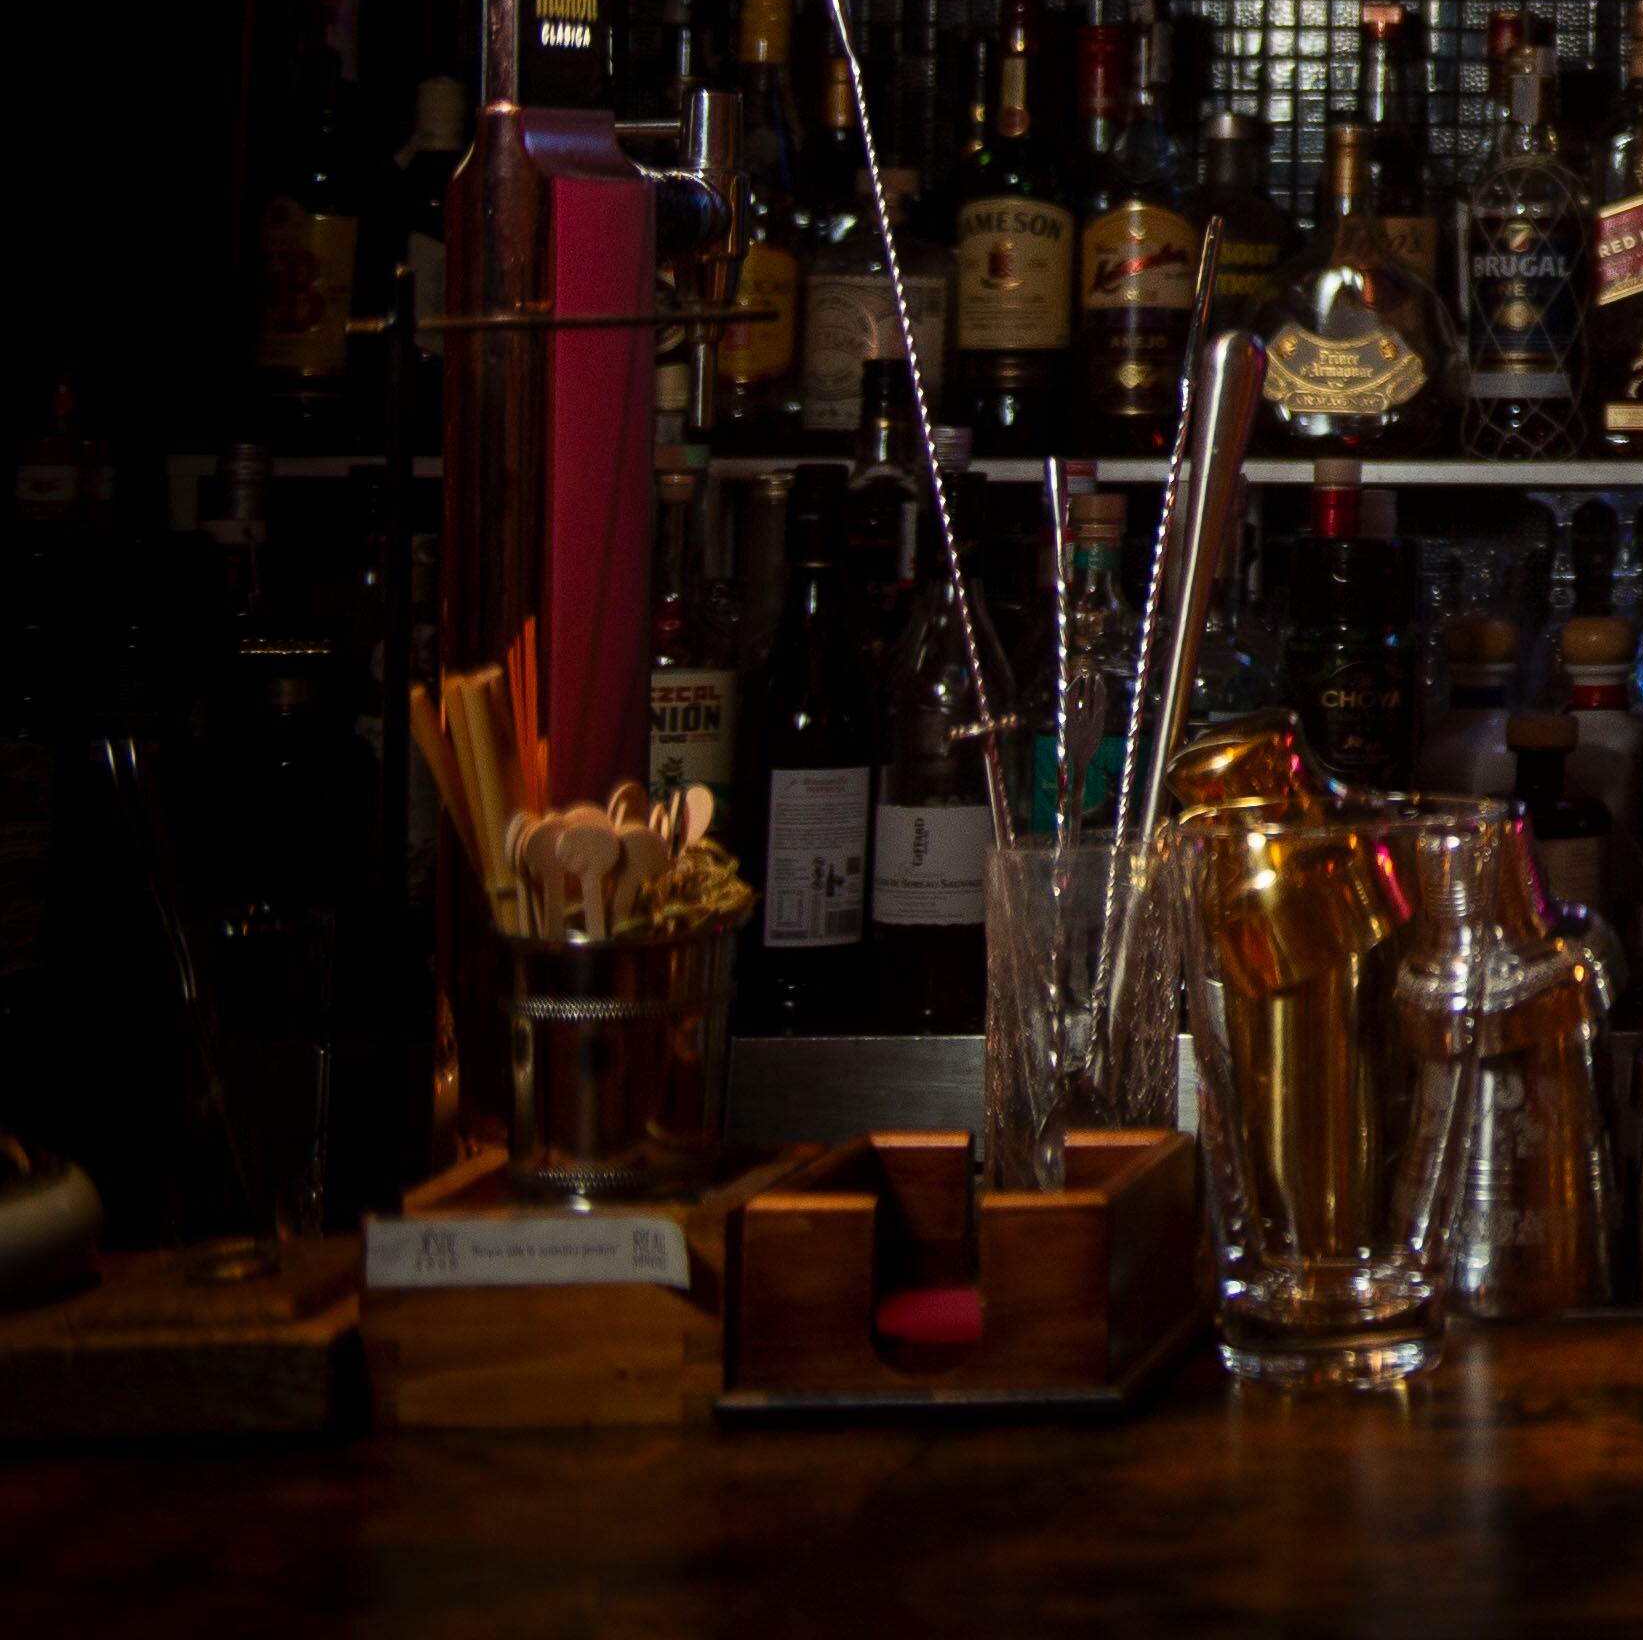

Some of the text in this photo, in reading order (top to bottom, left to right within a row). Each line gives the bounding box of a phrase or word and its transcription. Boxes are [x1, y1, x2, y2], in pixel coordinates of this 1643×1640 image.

[961, 211, 1060, 241] AMESON
[1598, 234, 1636, 258] RED
[1472, 254, 1569, 278] BRUGAL
[651, 686, 721, 702] EZCAL
